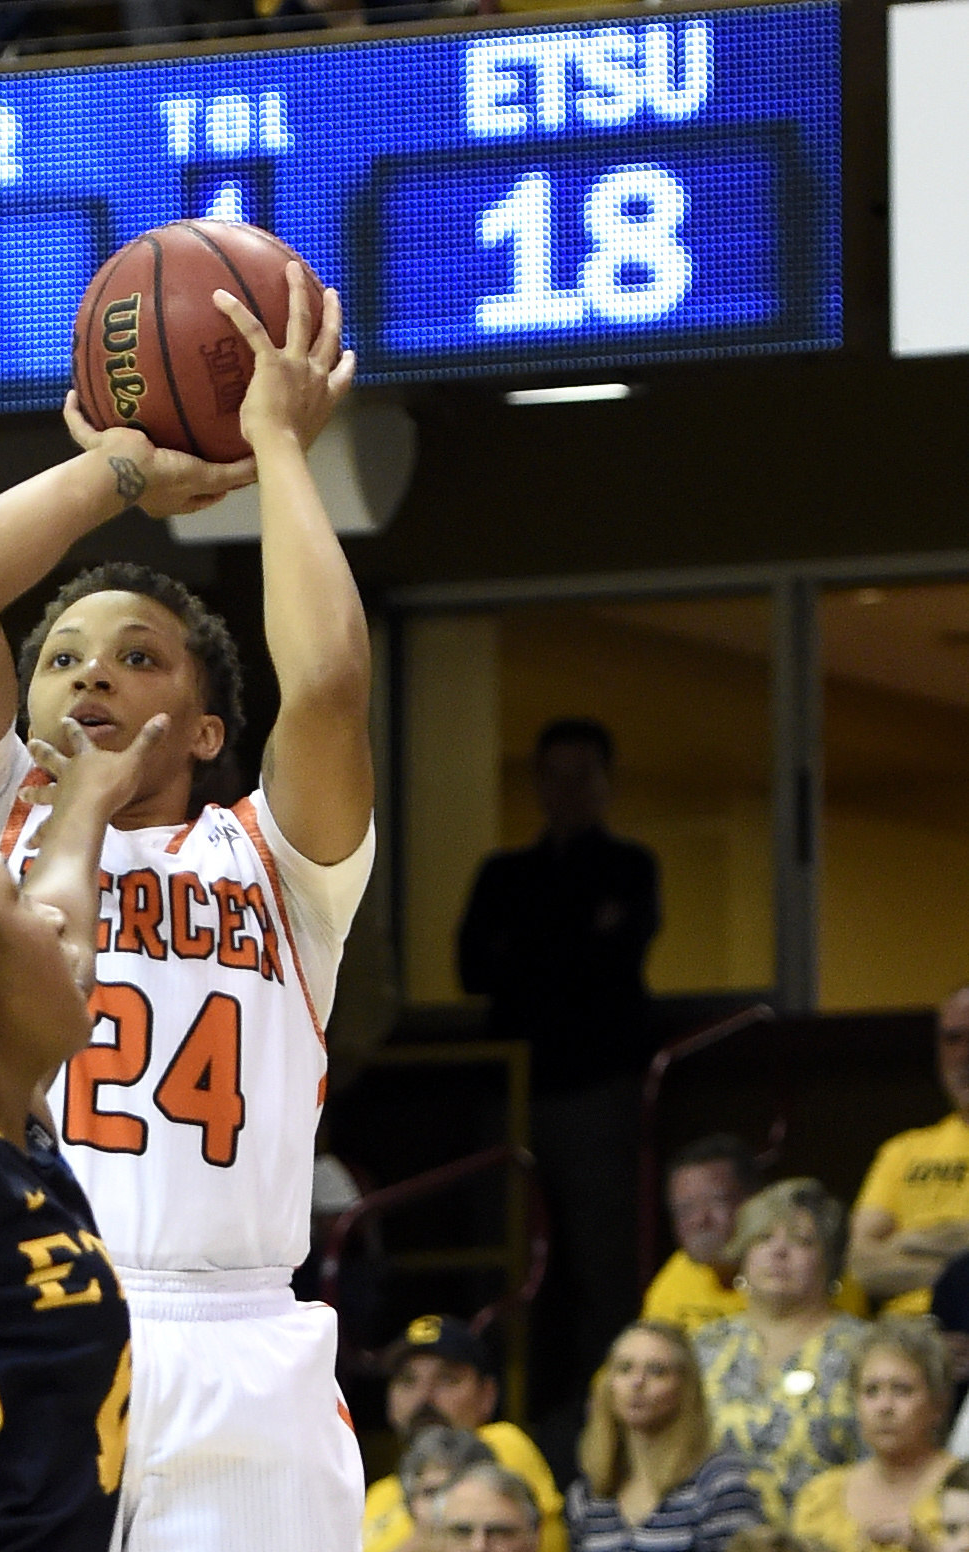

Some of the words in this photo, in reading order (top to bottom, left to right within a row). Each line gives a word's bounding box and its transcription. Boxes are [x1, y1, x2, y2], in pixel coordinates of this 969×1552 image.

[464, 19, 714, 139] ETSU
[475, 163, 692, 333] 18
[101, 292, 148, 431] Wils
[62, 978, 246, 1168] 24
